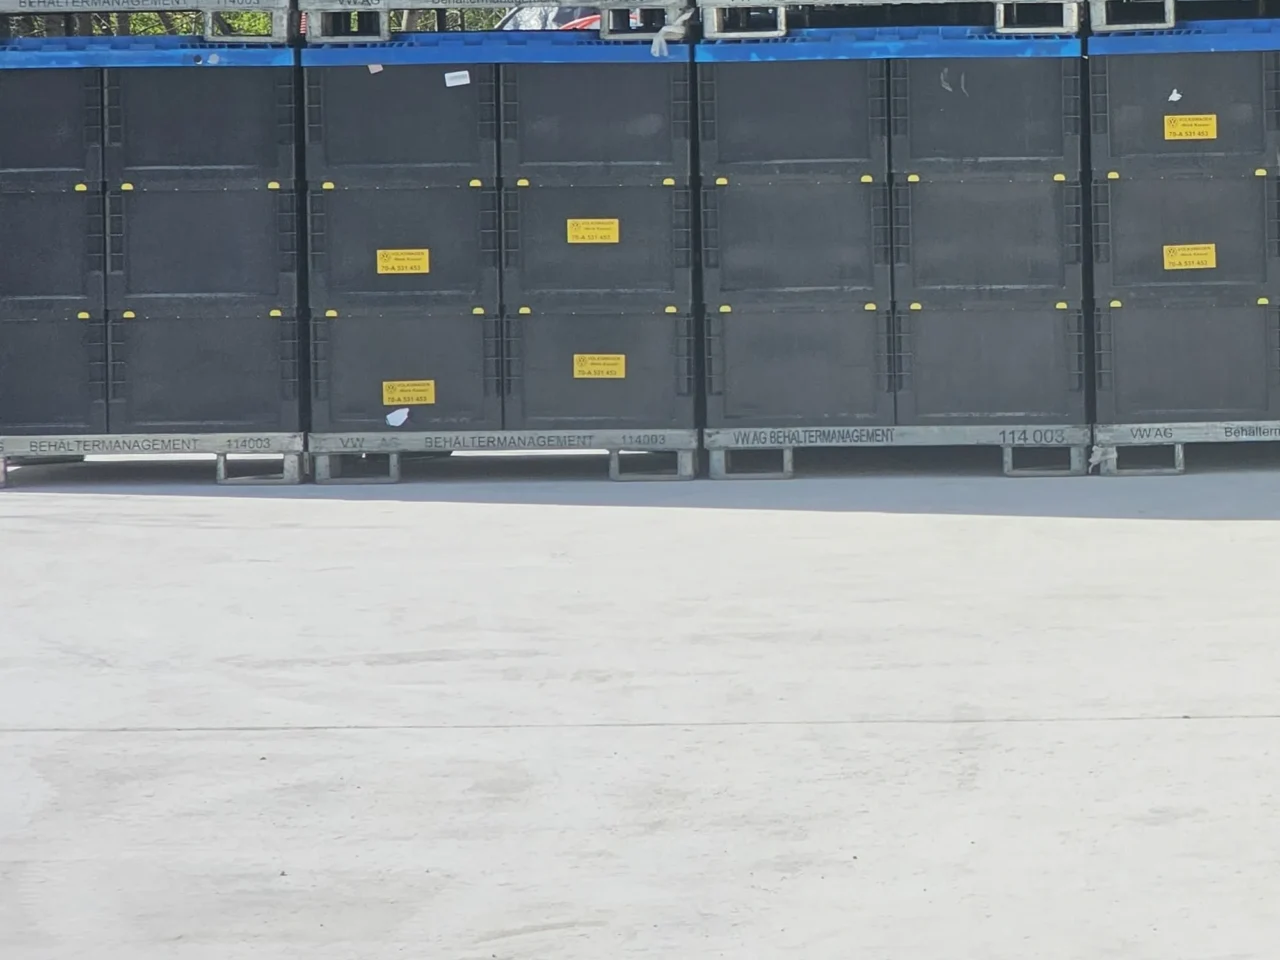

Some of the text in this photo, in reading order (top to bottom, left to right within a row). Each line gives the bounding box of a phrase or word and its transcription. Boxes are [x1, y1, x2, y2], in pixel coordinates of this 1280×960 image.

[733, 431, 750, 445] VW
[751, 430, 767, 444] AG
[999, 429, 1028, 444] 114
[1130, 428, 1153, 439] VW
[1154, 427, 1173, 438] AG
[226, 437, 271, 449] 114003
[340, 438, 365, 448] VW
